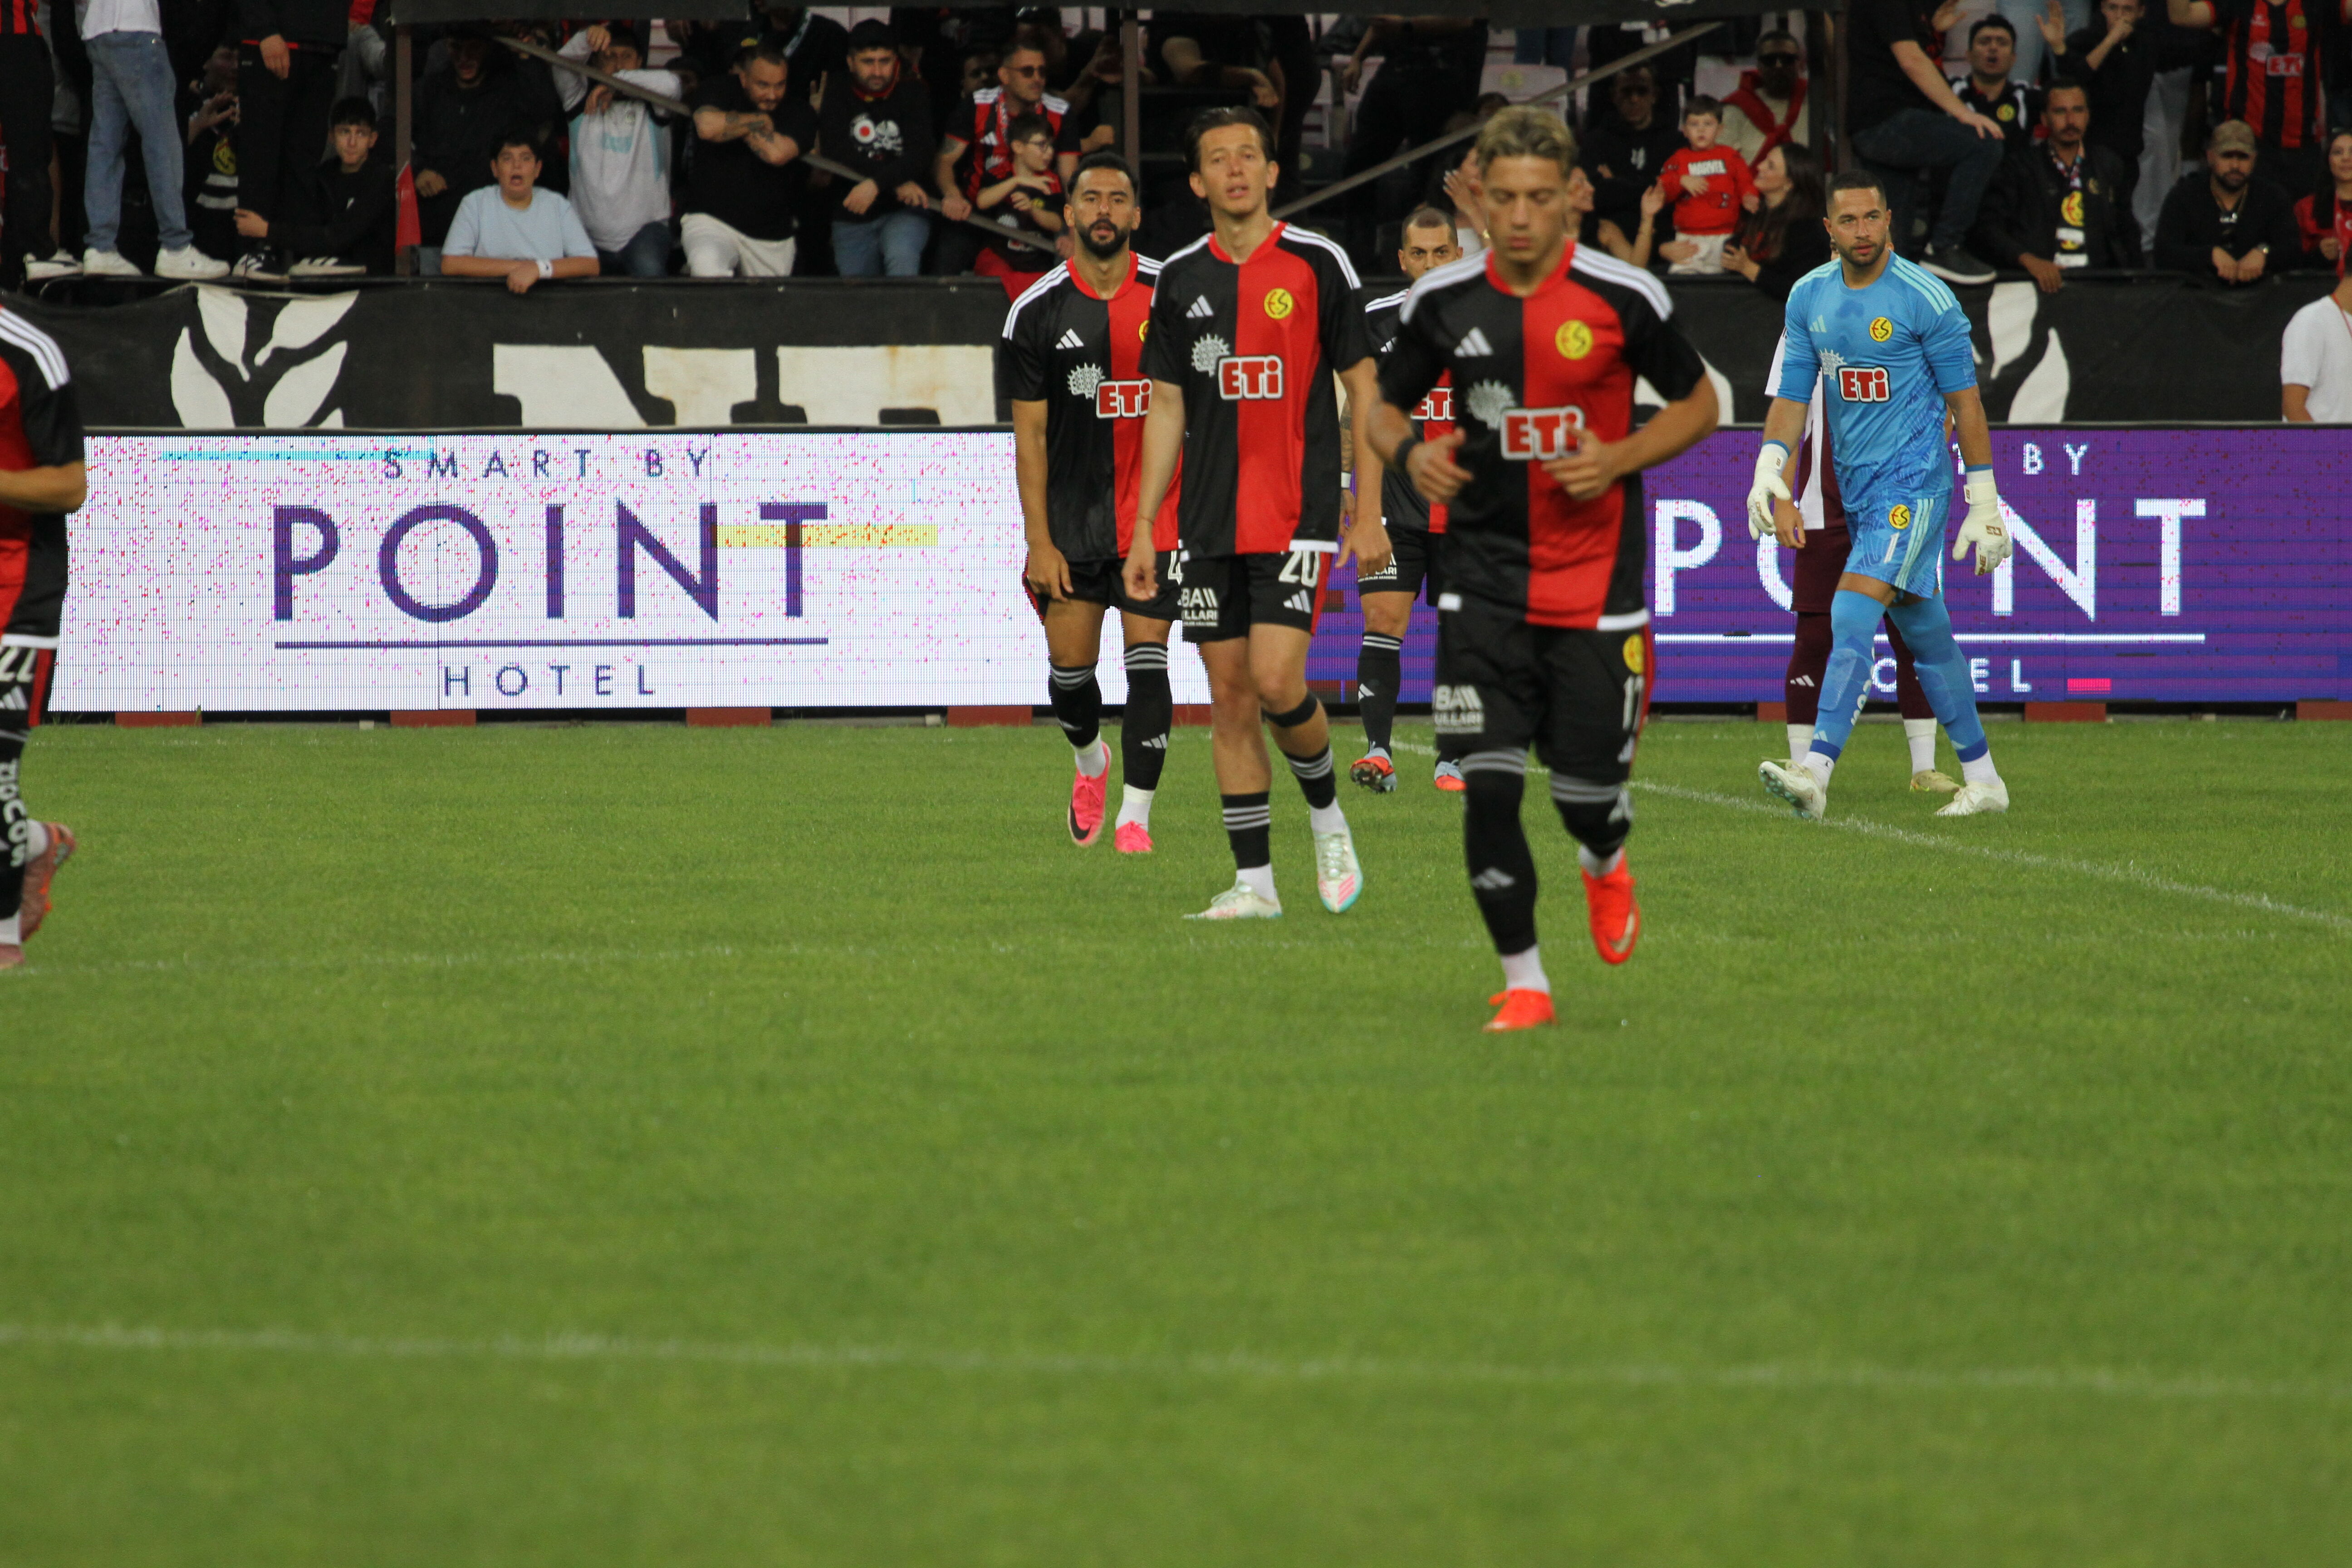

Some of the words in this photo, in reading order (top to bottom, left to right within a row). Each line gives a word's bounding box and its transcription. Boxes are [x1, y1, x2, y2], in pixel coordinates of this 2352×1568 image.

[383, 448, 591, 479] SMART
[645, 448, 709, 477] BY
[2023, 442, 2088, 475] BY
[273, 501, 828, 623] POINT
[1655, 498, 2206, 621] PNT
[1884, 532, 1900, 564] 1
[1279, 550, 1320, 588] 20
[444, 665, 655, 696] HOTEL
